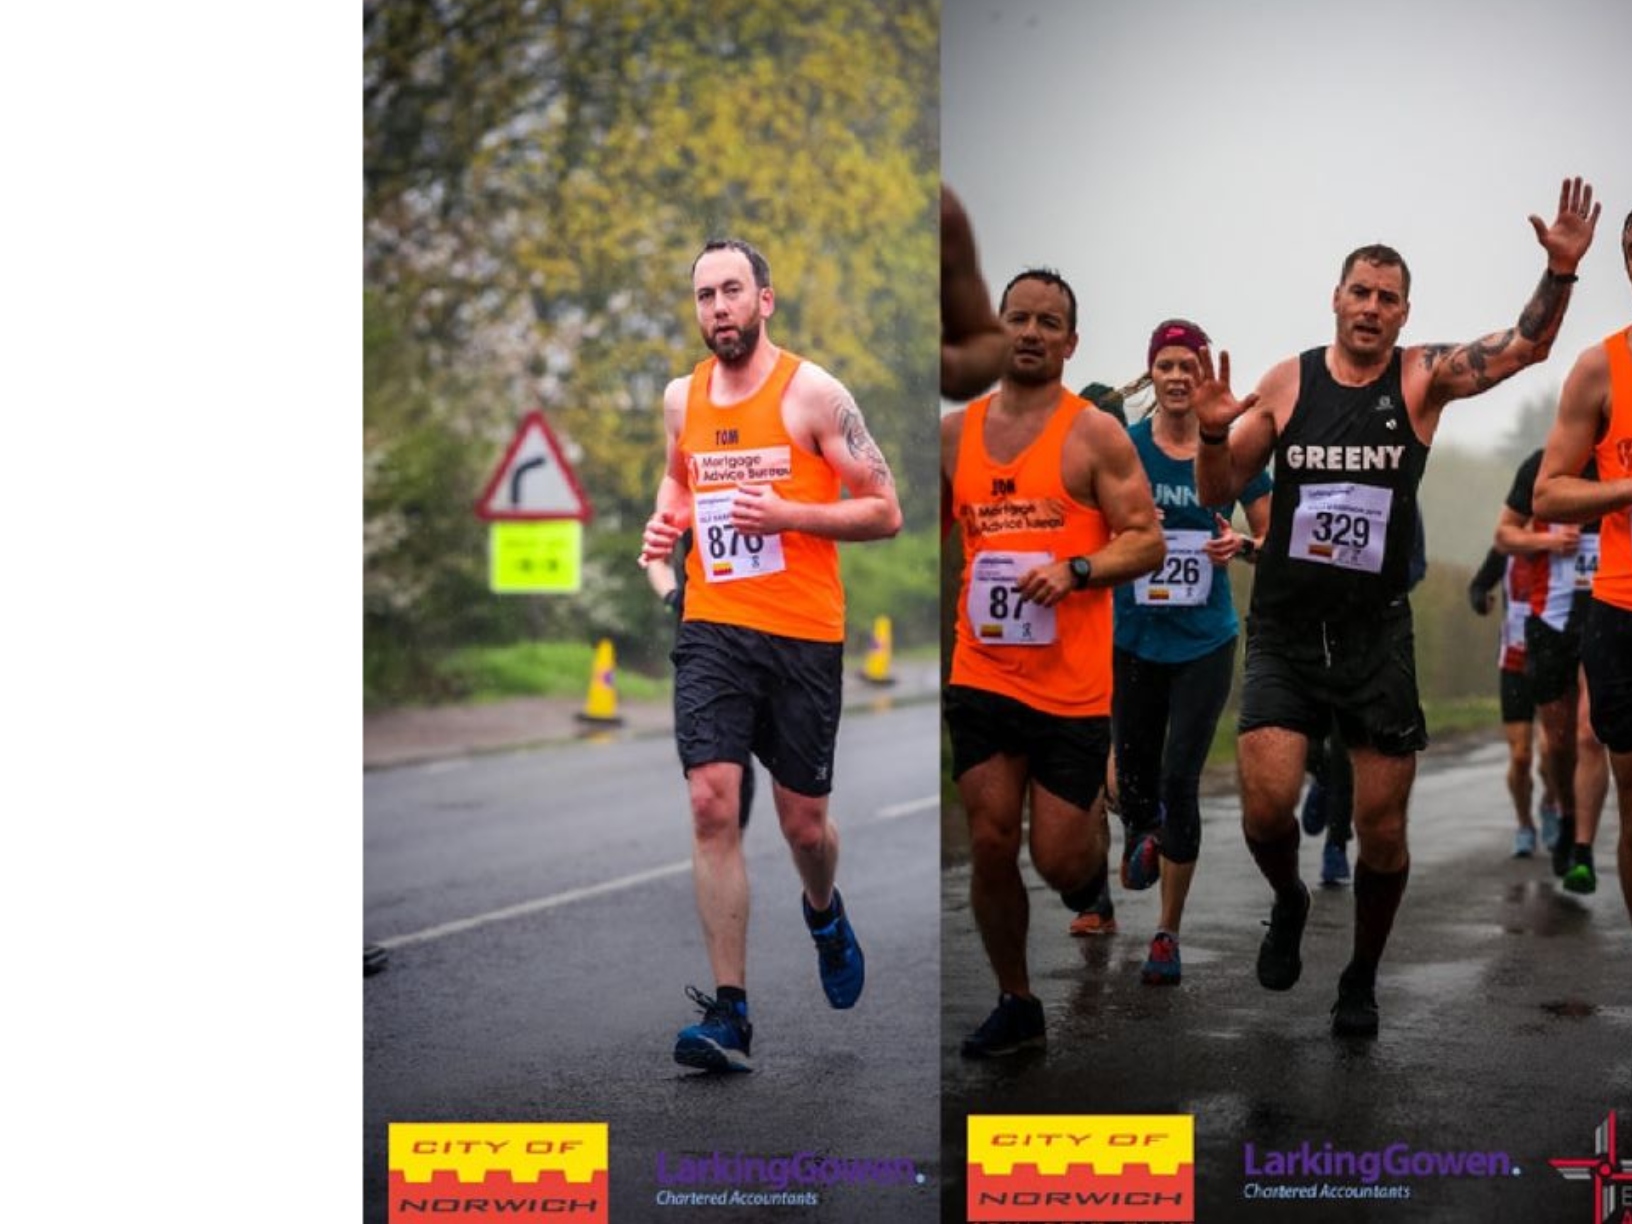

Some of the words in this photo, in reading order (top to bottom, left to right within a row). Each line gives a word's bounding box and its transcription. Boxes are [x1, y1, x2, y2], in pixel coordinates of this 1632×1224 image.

[715, 429, 739, 445] TOM
[702, 455, 762, 468] Mortgage
[1286, 445, 1405, 471] GREENY
[703, 470, 746, 481] Advice
[708, 525, 764, 558] 876
[1312, 512, 1370, 548] 329
[989, 586, 1029, 620] 87
